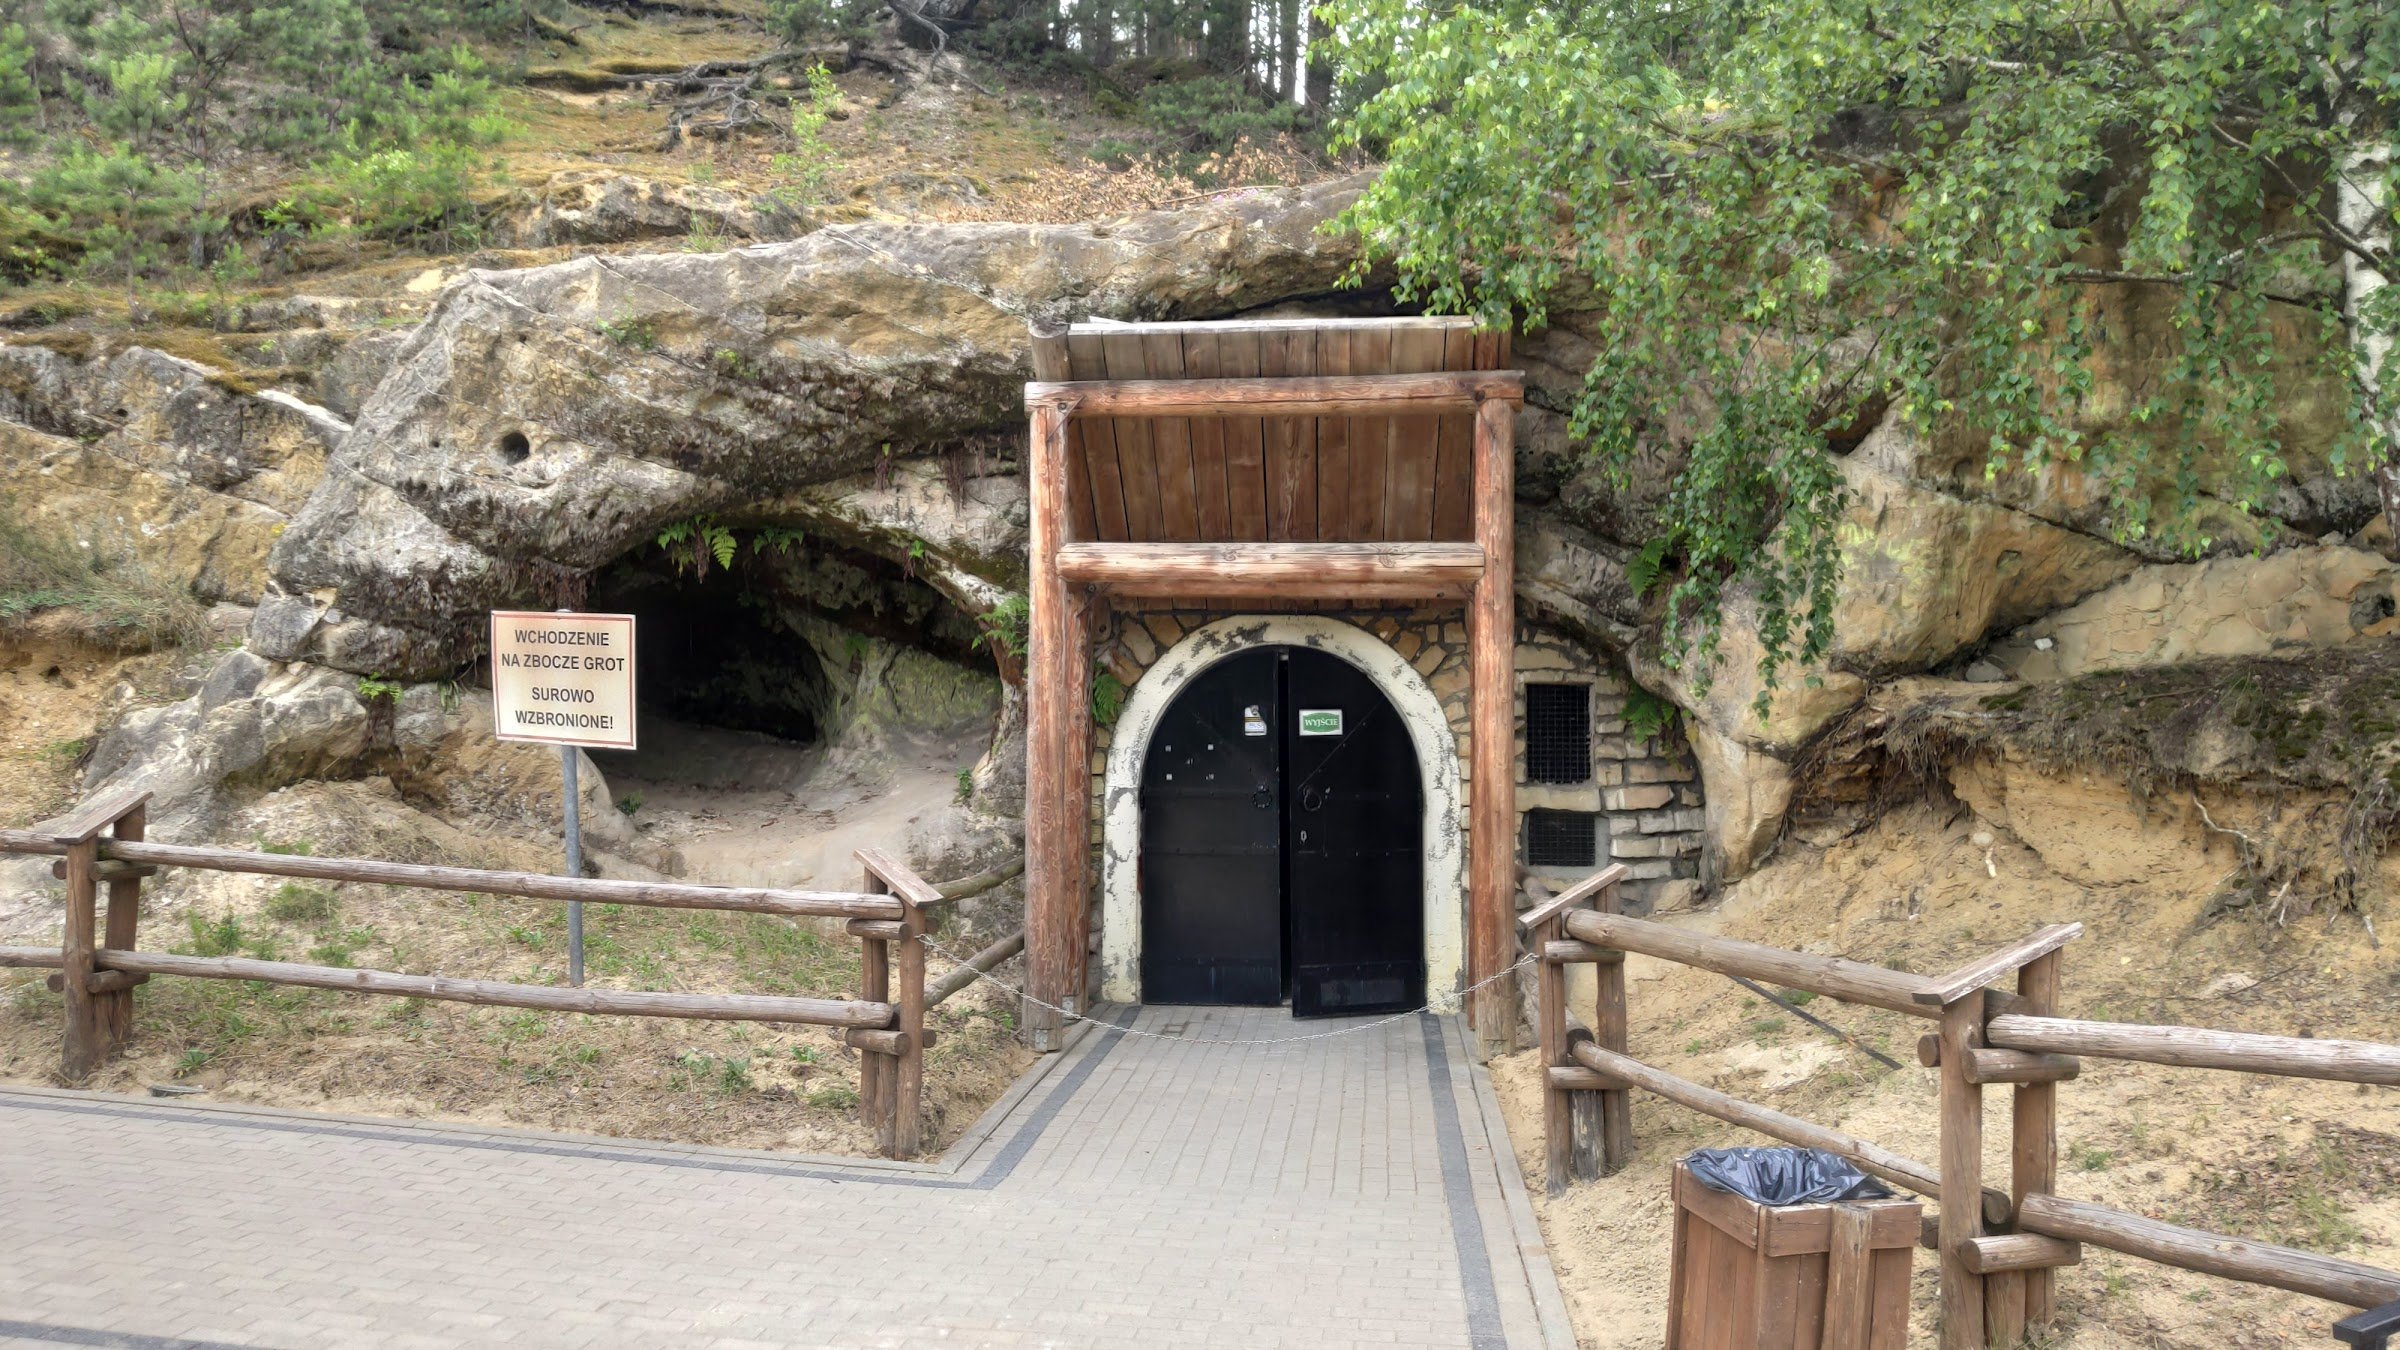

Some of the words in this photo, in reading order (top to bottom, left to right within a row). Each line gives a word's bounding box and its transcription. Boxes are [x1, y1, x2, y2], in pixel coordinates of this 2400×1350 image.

[515, 630, 609, 646] WCHODZENIE
[502, 653, 520, 667] NA
[524, 654, 579, 669] ZBOCZE
[584, 656, 625, 671] GROT
[532, 687, 595, 703] SUROWO
[515, 710, 613, 729] WZBRONIONE!
[1305, 717, 1338, 728] WYJŚCIE
